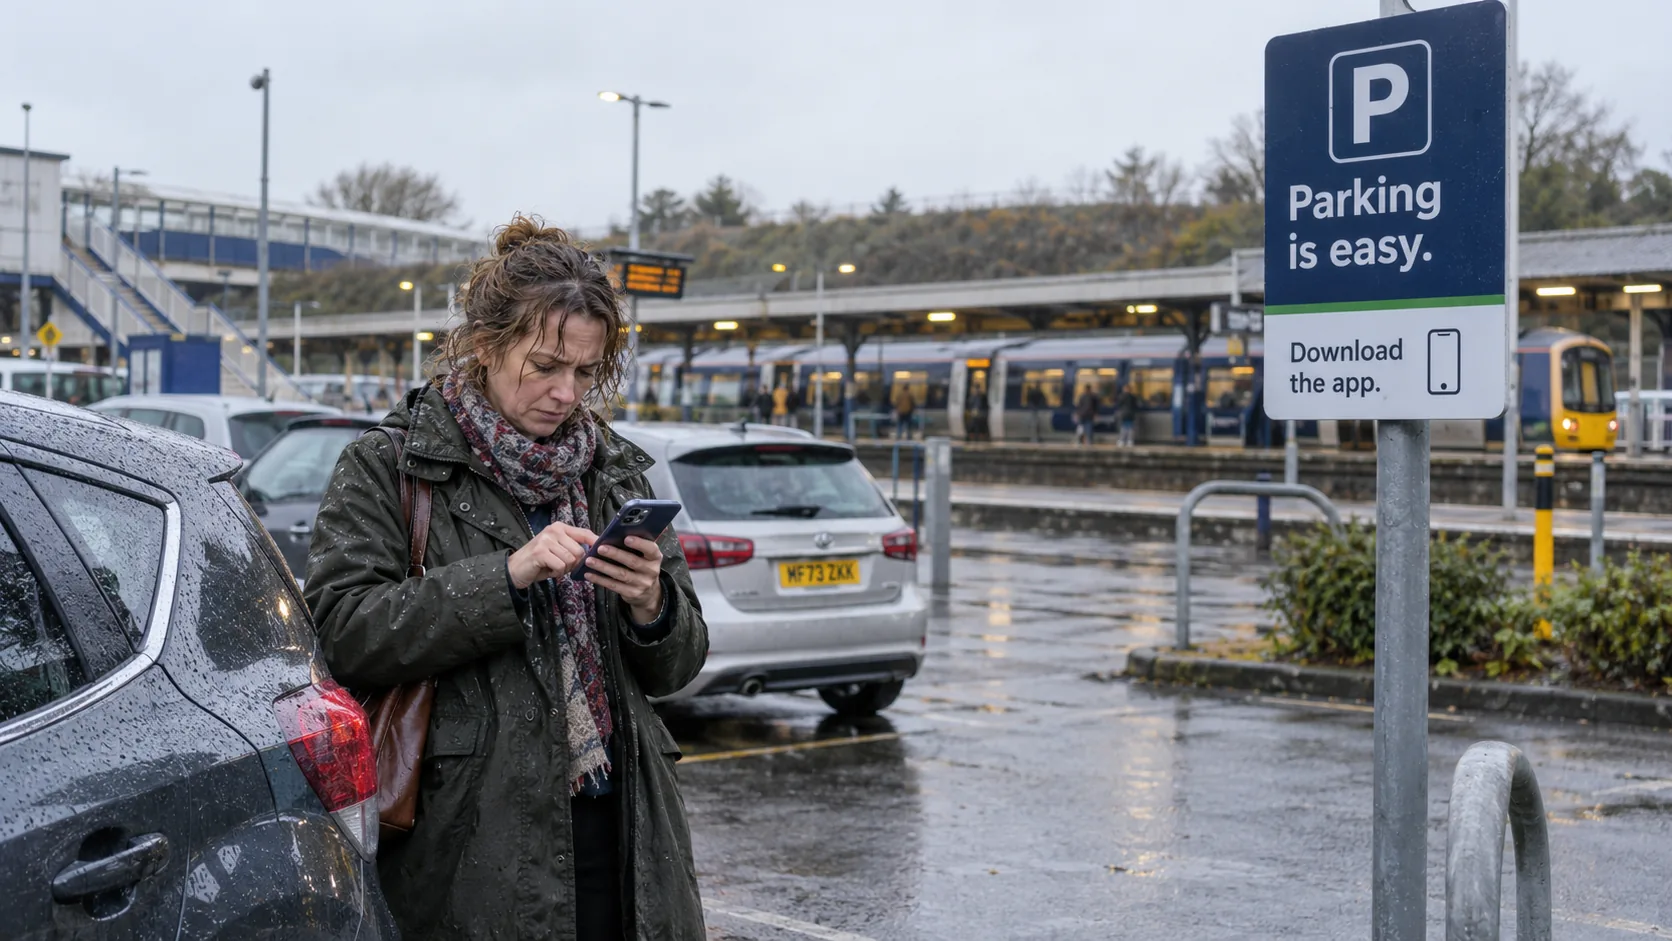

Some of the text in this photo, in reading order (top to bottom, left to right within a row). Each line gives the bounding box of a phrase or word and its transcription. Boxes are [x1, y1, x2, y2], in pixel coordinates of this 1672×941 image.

[1353, 62, 1410, 145] P
[1289, 176, 1441, 222] Parking
[1289, 233, 1432, 273] is easy.
[1290, 338, 1403, 363] Download
[1289, 372, 1381, 398] the app.
[827, 562, 855, 581] ZKK
